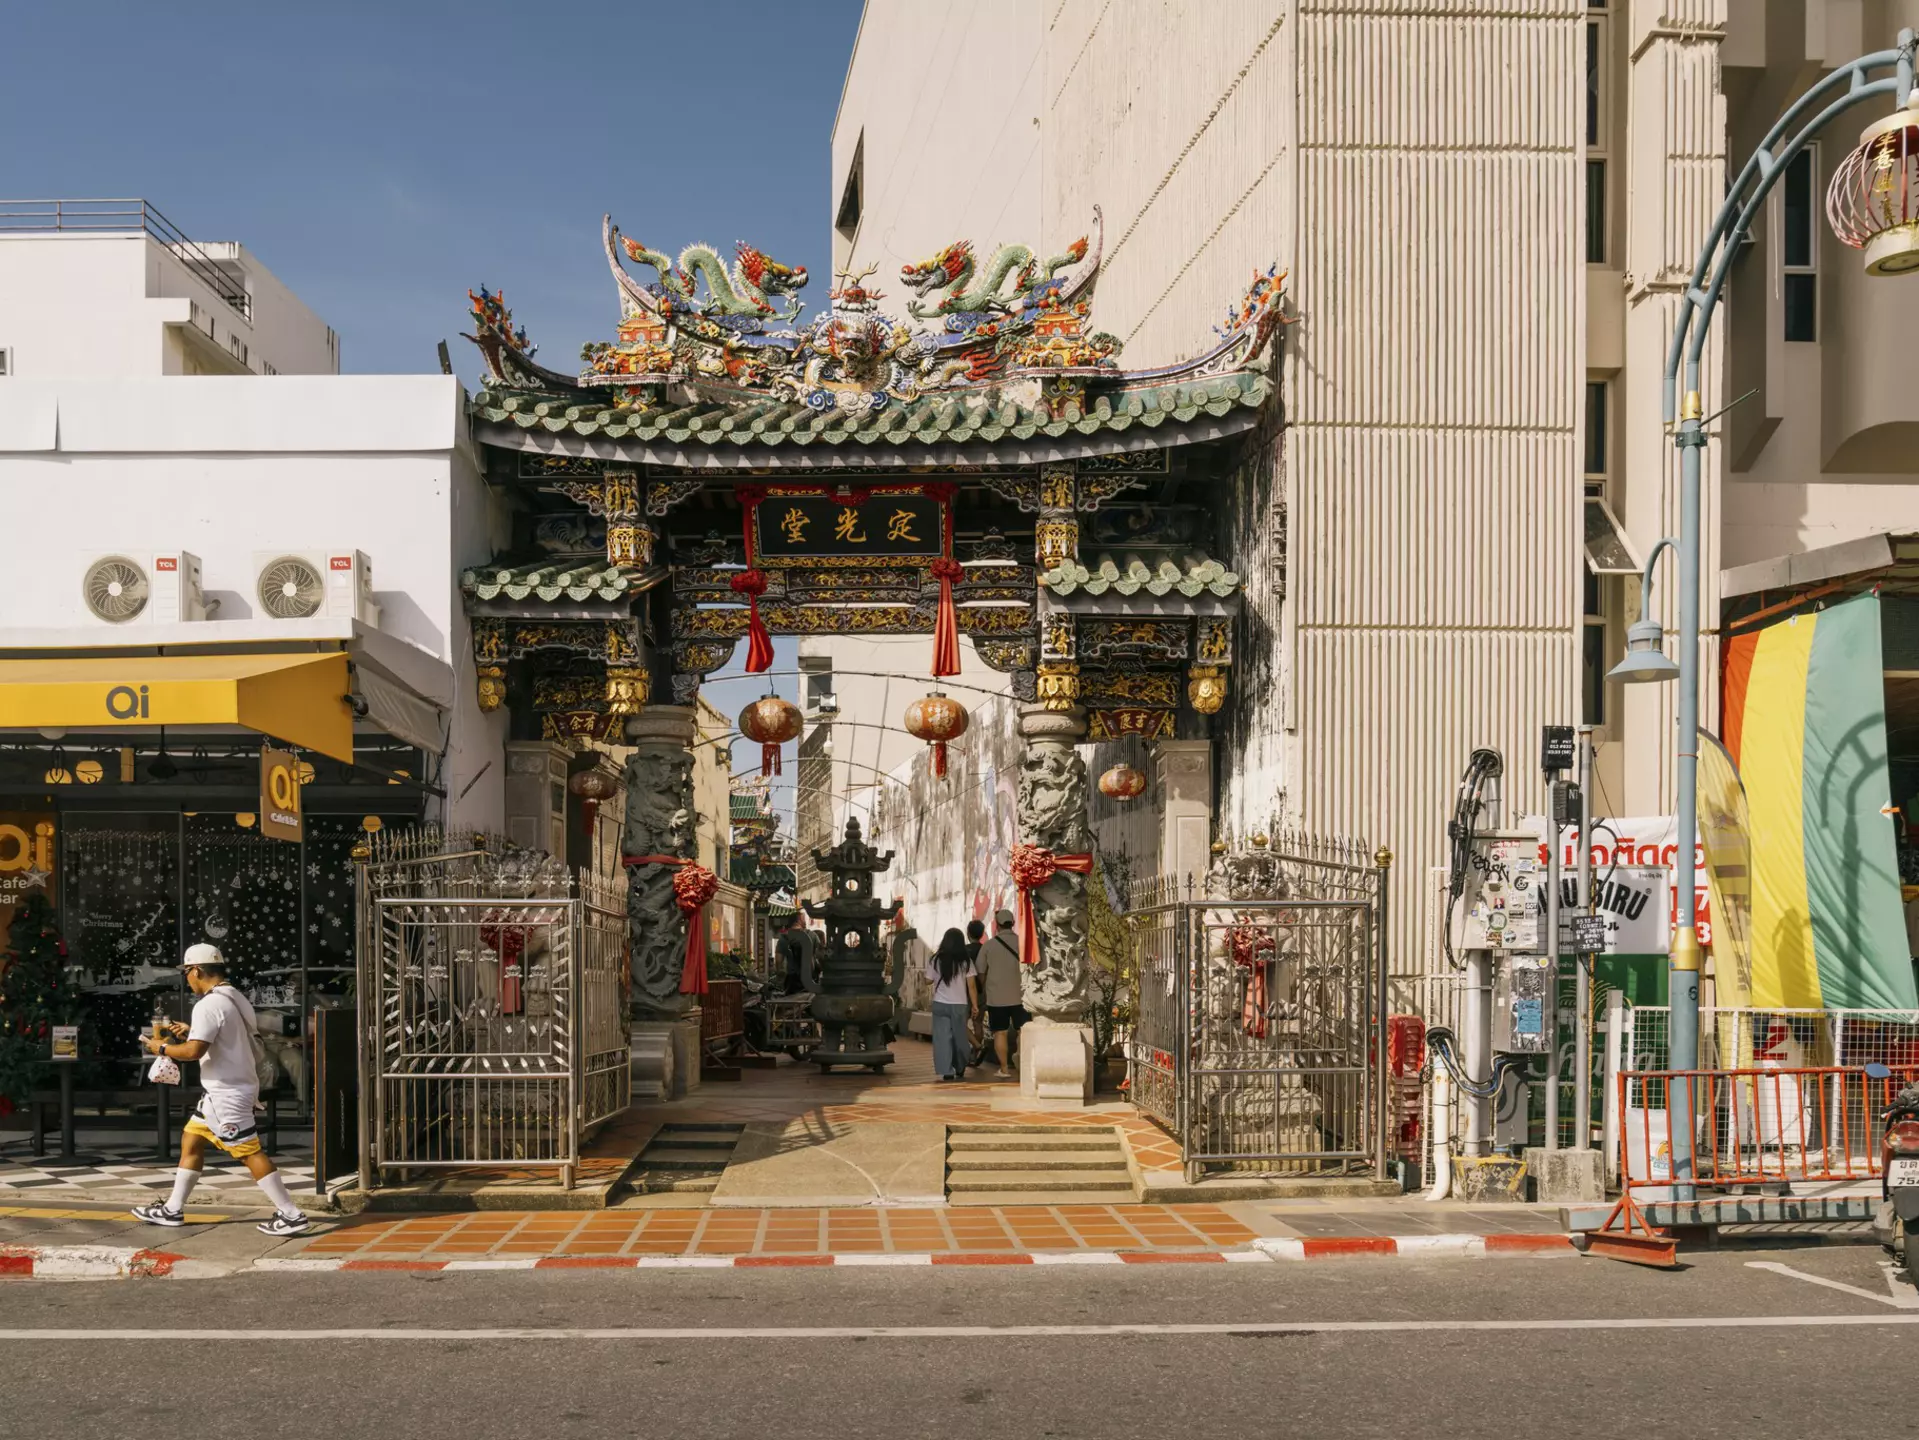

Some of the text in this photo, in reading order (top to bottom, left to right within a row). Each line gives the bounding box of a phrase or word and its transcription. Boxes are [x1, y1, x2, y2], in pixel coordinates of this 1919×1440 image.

[106, 684, 149, 719] Qi
[269, 765, 298, 813] Qi
[80, 918, 123, 928] Christmas
[89, 912, 112, 921] Merry
